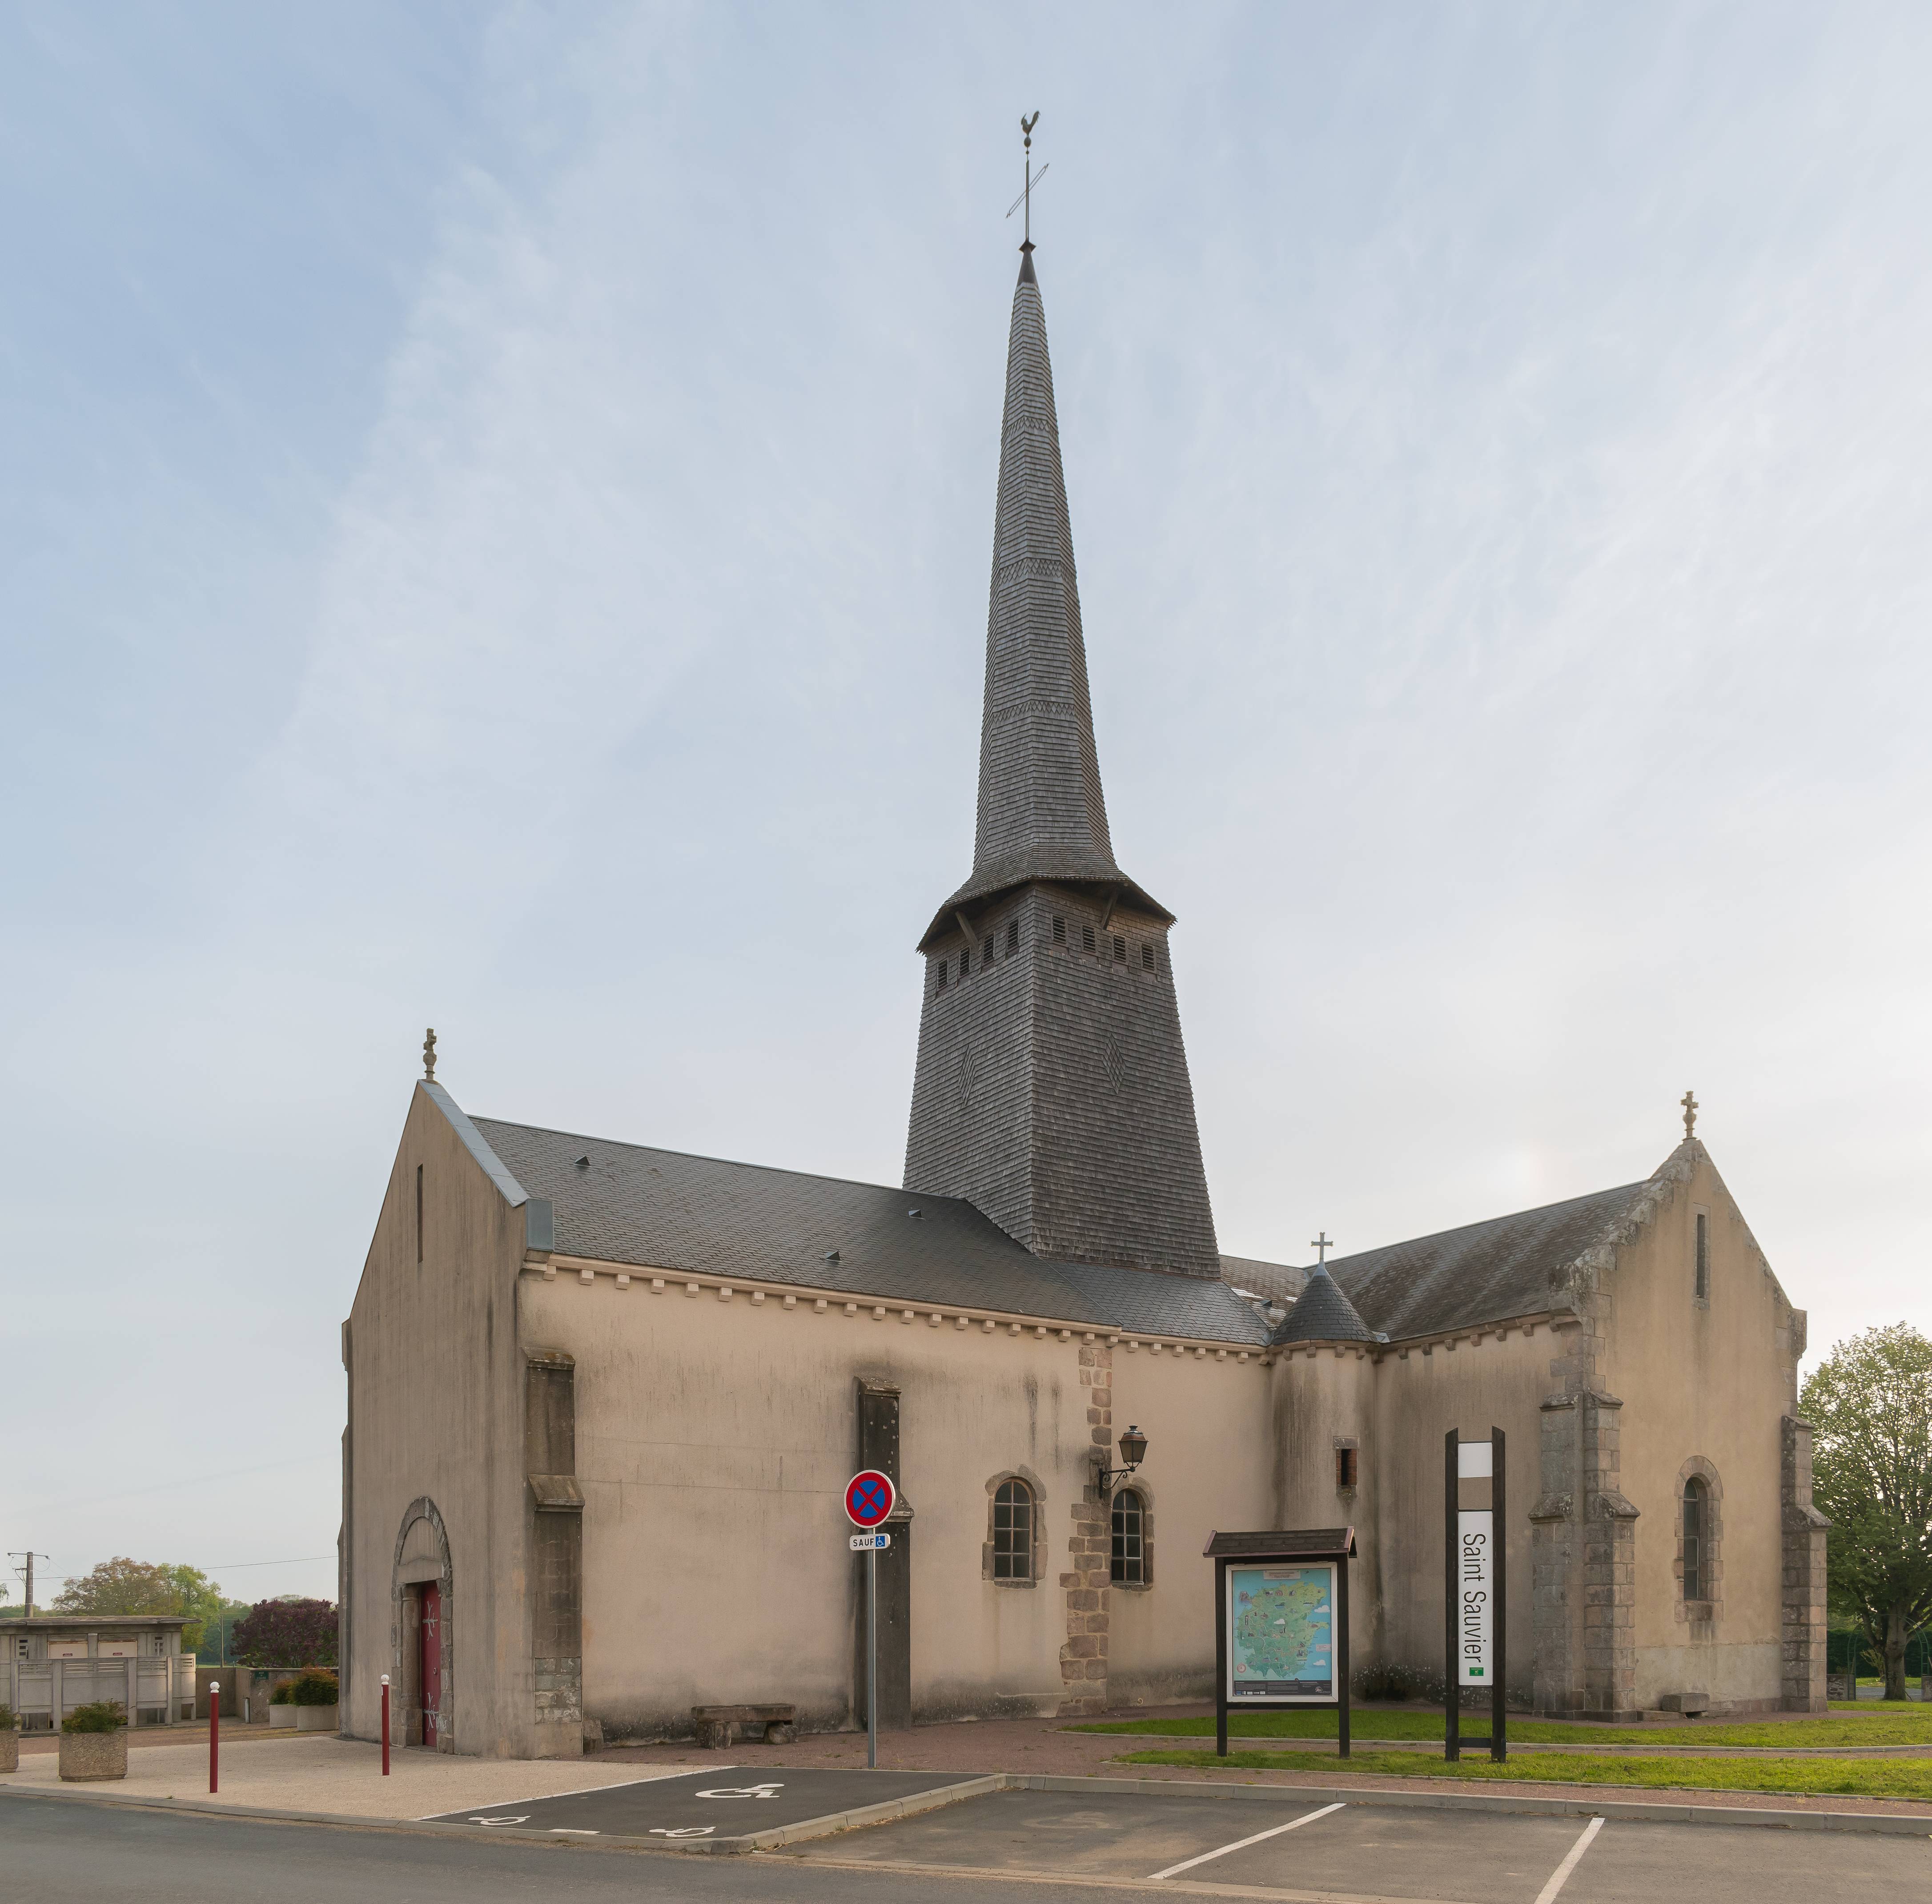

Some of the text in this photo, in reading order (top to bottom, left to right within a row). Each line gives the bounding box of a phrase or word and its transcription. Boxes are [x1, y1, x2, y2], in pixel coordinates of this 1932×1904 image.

[853, 1538, 874, 1546] SAUF
[1463, 1534, 1486, 1582] Saint
[1464, 1591, 1486, 1663] Sauvier
